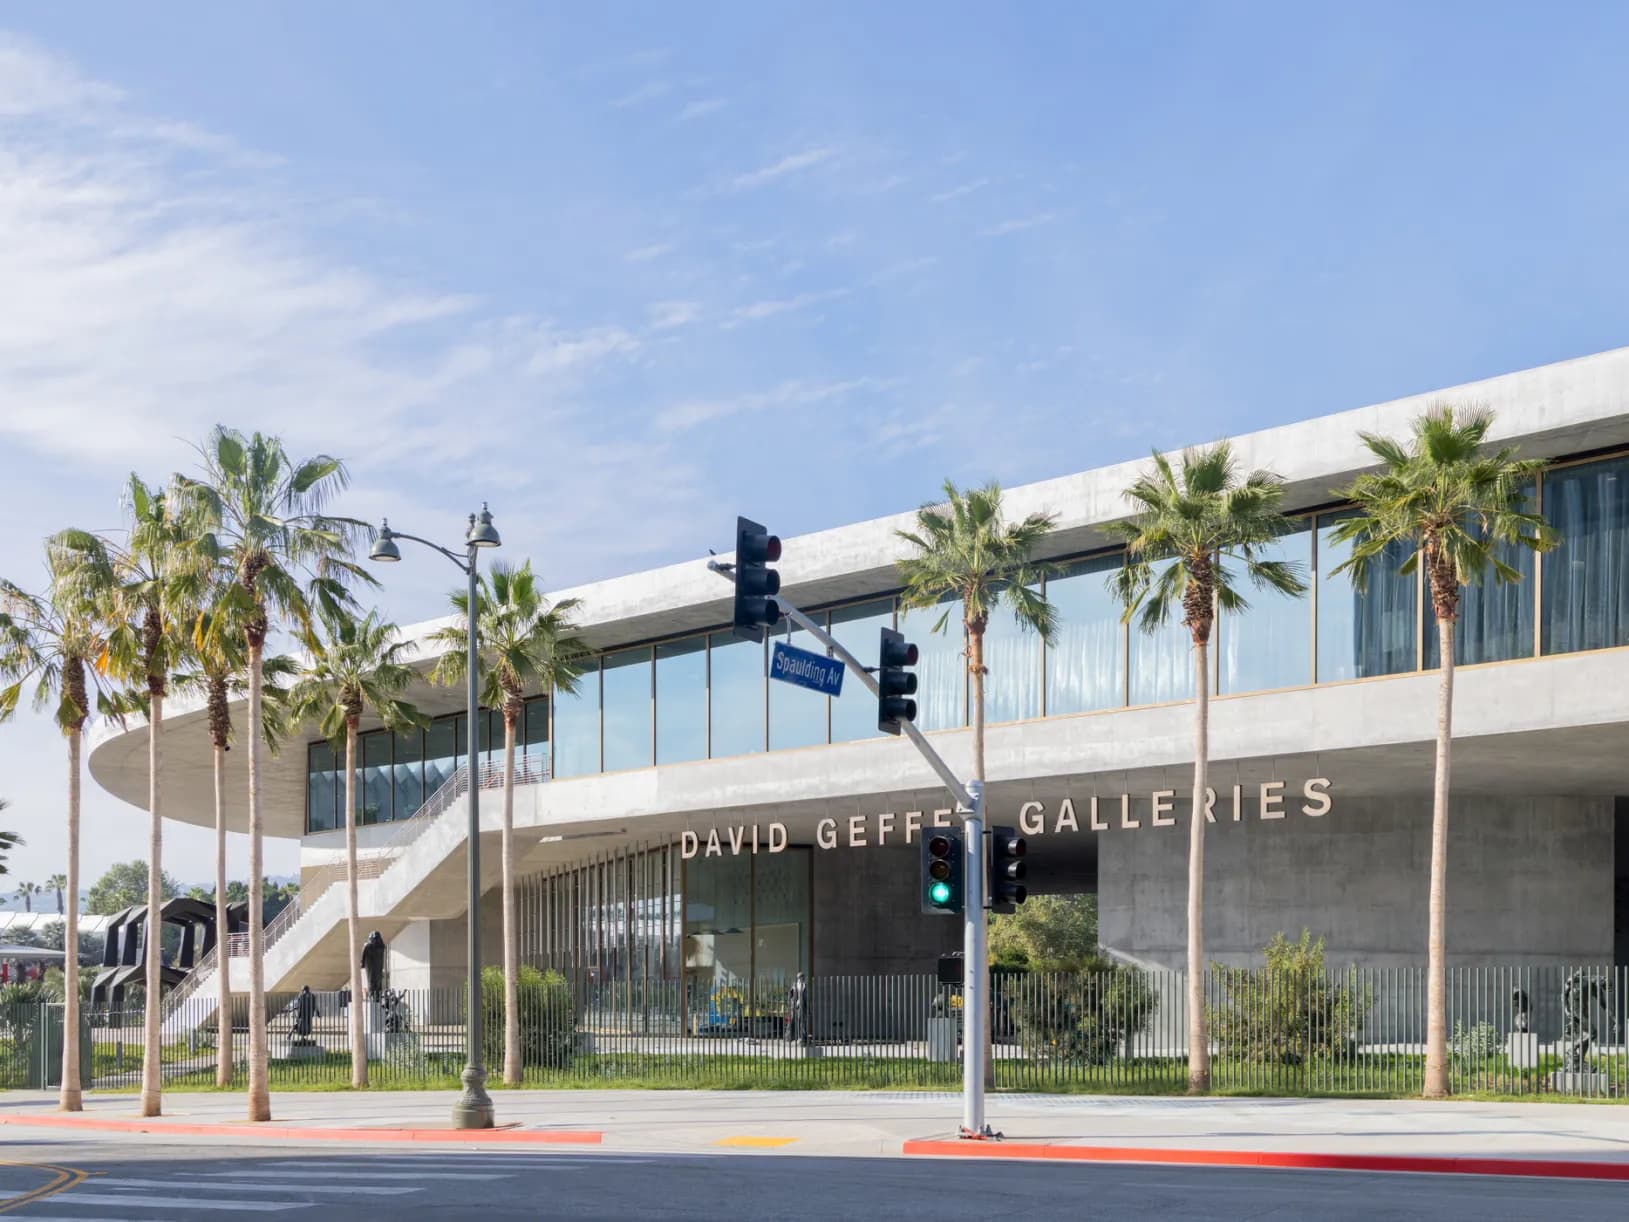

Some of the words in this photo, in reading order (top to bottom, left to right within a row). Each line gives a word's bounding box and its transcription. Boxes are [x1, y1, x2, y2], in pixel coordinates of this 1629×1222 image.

[776, 651, 826, 687] Spaulding
[826, 667, 841, 686] Av
[681, 822, 788, 859] DAVID
[816, 809, 954, 850] GEFFE
